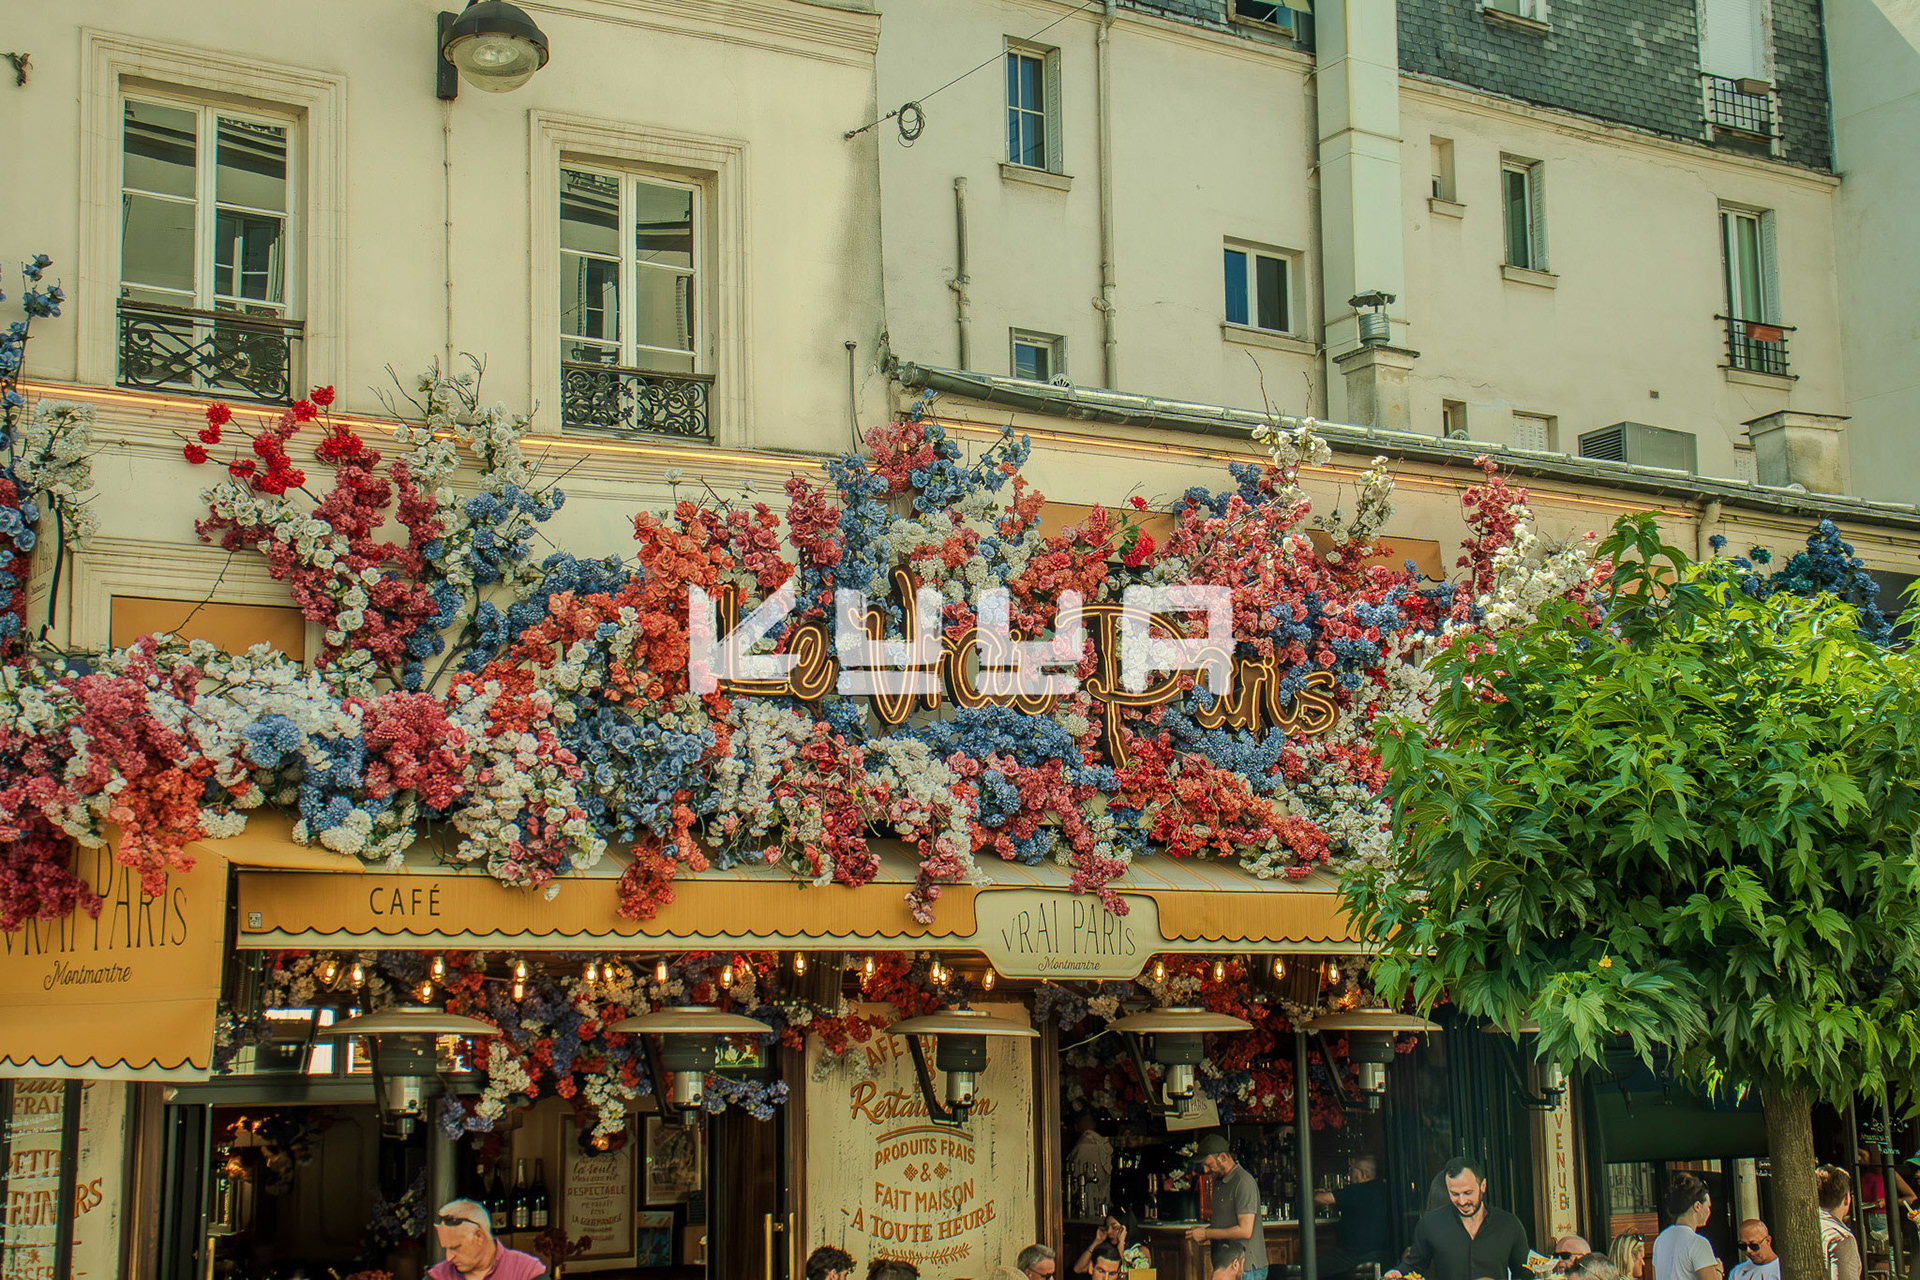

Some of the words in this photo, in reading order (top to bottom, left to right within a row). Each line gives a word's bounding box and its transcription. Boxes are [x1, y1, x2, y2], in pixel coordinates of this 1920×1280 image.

[711, 580, 839, 700] Le
[847, 565, 1055, 726] Vrai
[1054, 602, 1340, 768] Paris
[370, 883, 440, 916] CAFÉ
[1001, 900, 1059, 953] VRAI
[1072, 900, 1136, 956] PARIS
[43, 960, 132, 990] Montmartre
[1038, 956, 1101, 971] Montmartre
[875, 1138, 937, 1170] PRODUITS
[941, 1139, 975, 1165] FRAIS
[920, 1162, 932, 1182] &
[875, 1181, 912, 1212] FAIT
[915, 1178, 974, 1213] MAISON
[870, 1214, 933, 1243] TOUTE
[938, 1200, 996, 1240] HEURE
